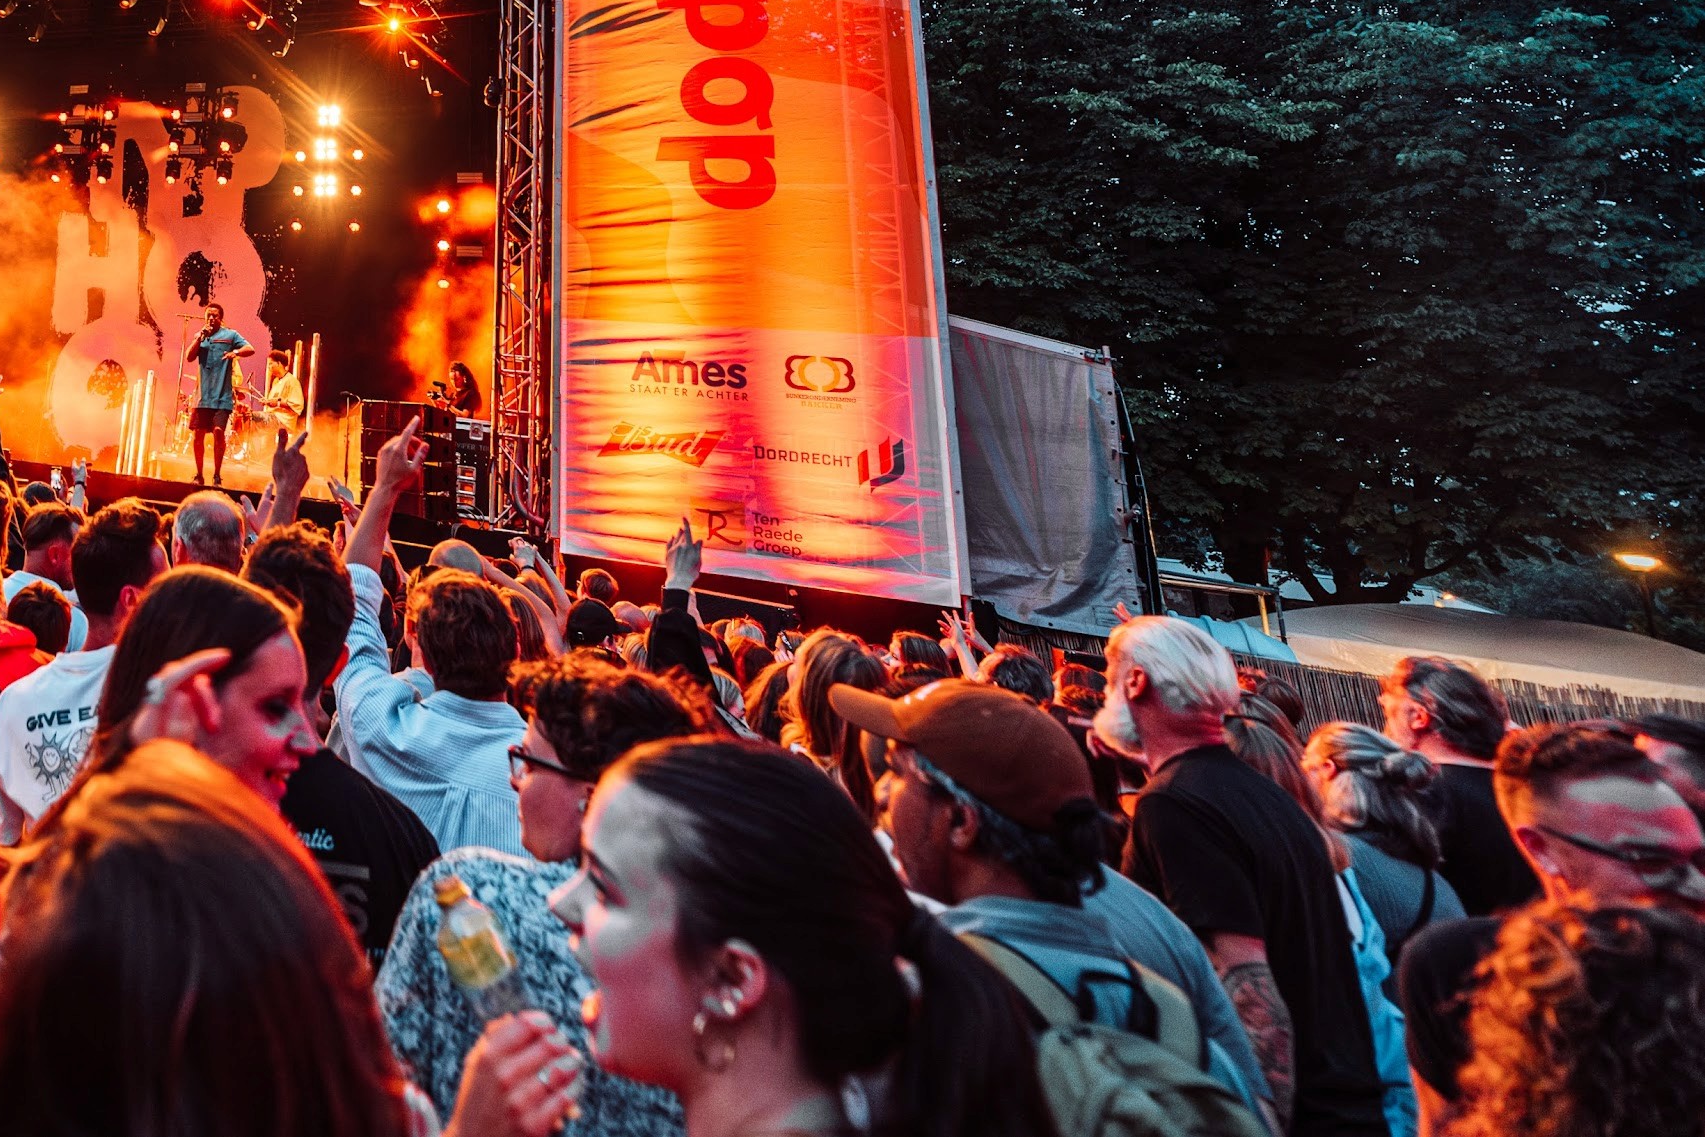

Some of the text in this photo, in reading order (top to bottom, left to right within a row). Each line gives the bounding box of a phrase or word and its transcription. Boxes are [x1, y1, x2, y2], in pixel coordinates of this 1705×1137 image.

[631, 350, 748, 390] Ames
[629, 383, 749, 403] STAAT ER ACHTER
[611, 423, 706, 457] Bud
[752, 444, 853, 468] DORDRECHT
[752, 511, 781, 527] Ten
[753, 526, 804, 544] Raede
[753, 539, 803, 558] Groep
[26, 705, 99, 732] GIVE E
